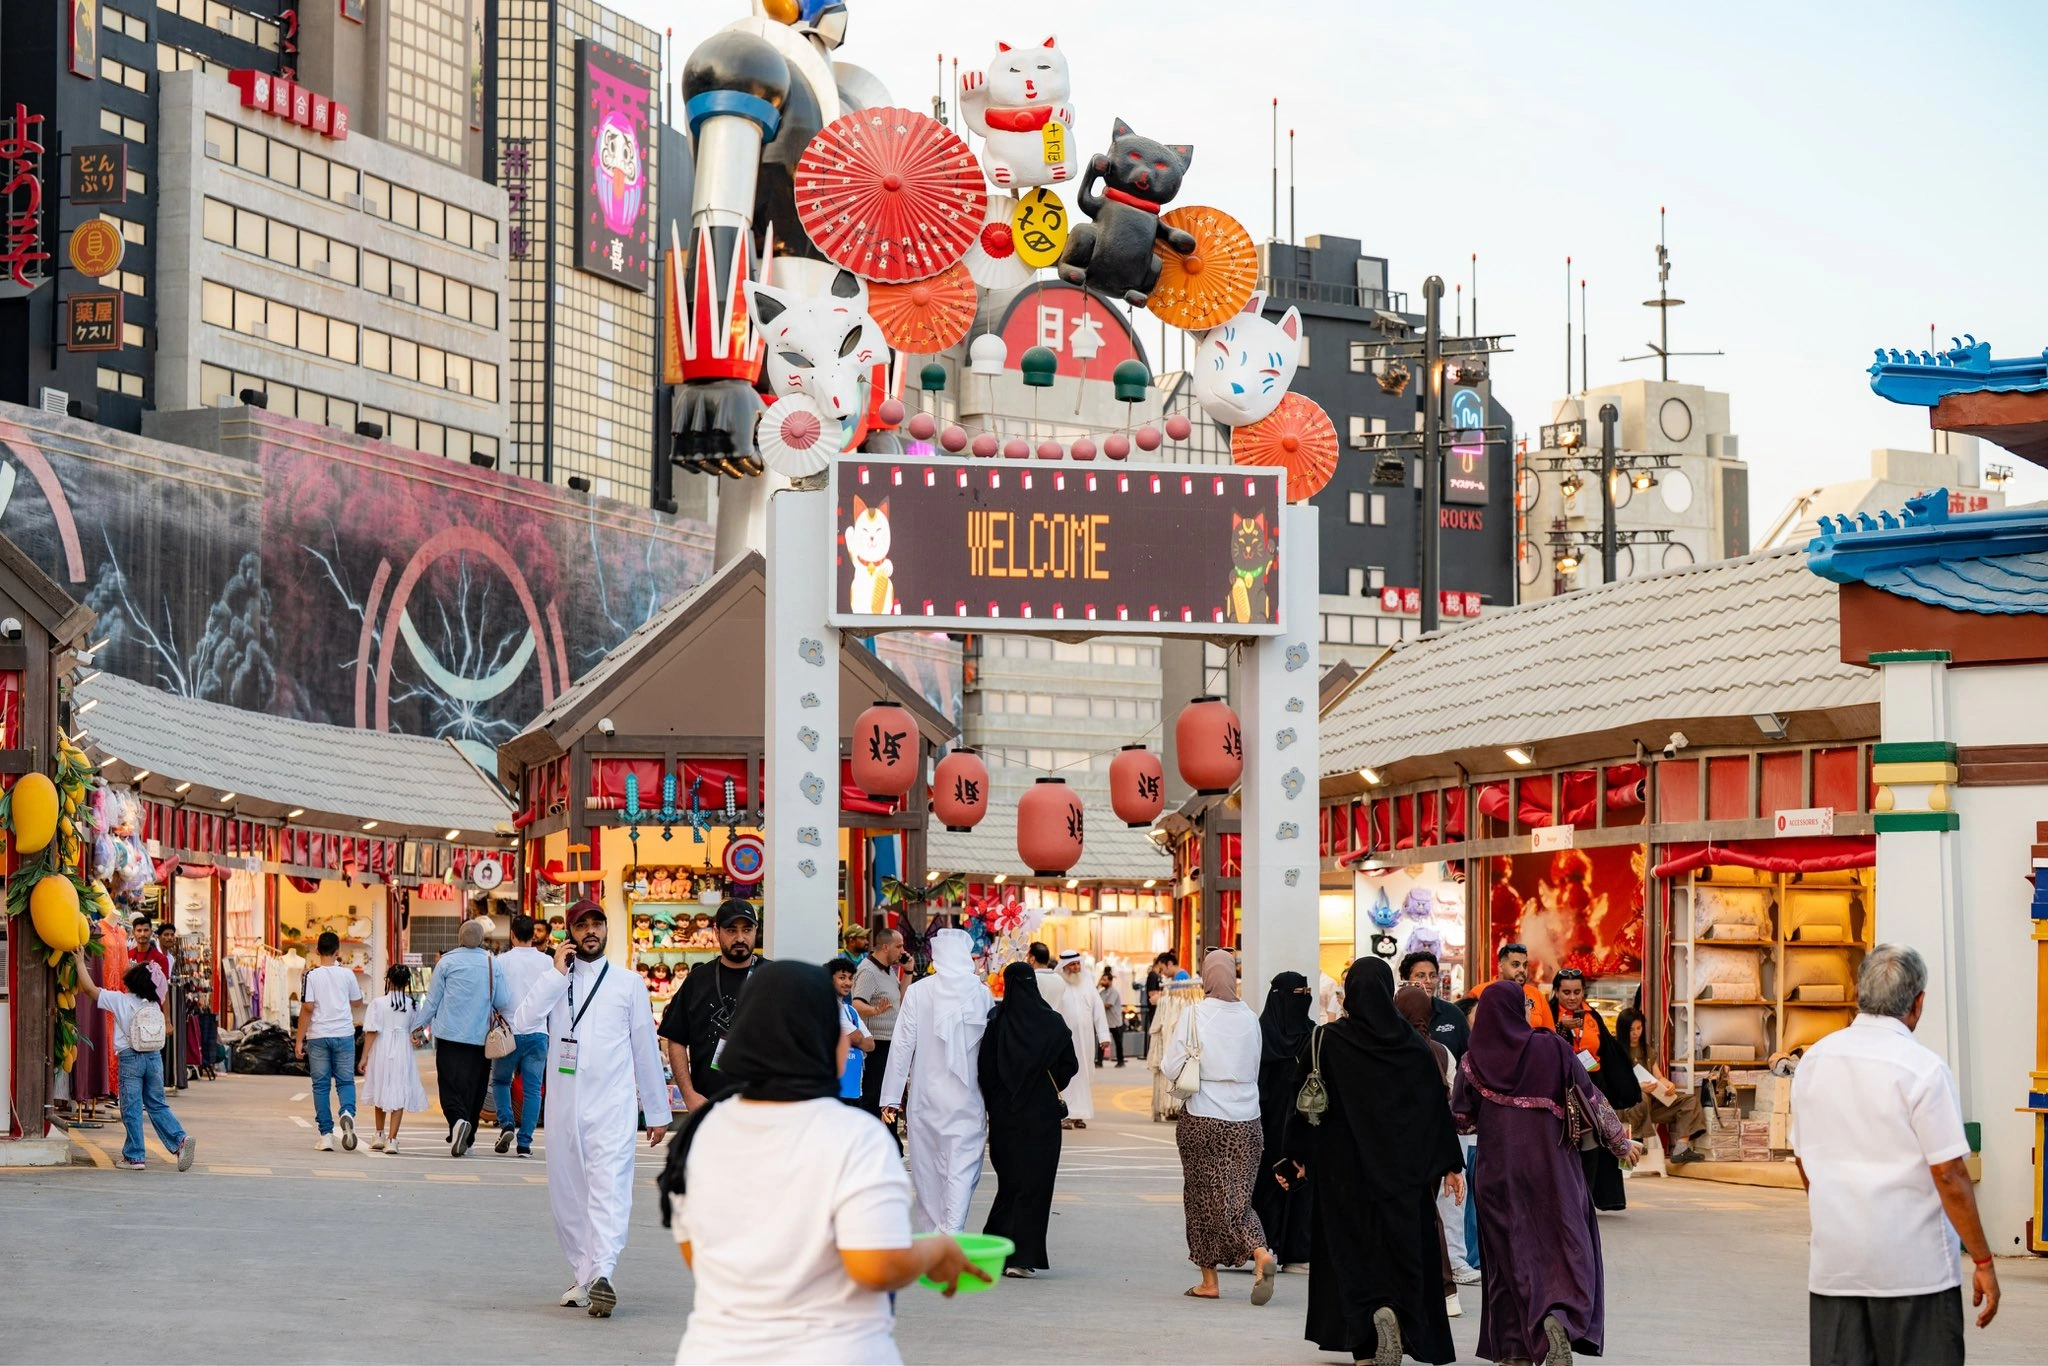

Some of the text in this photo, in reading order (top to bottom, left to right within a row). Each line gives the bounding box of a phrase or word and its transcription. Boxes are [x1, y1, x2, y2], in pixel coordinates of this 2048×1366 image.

[80, 154, 115, 172] どん
[80, 174, 114, 192] ぶり
[609, 238, 624, 273] 喜
[76, 301, 112, 322] 薬屋
[76, 325, 111, 341] クスリ
[1440, 508, 1483, 530] ROCKS
[968, 511, 1109, 579] WELCOME
[1788, 818, 1818, 826] ACCESSORIES
